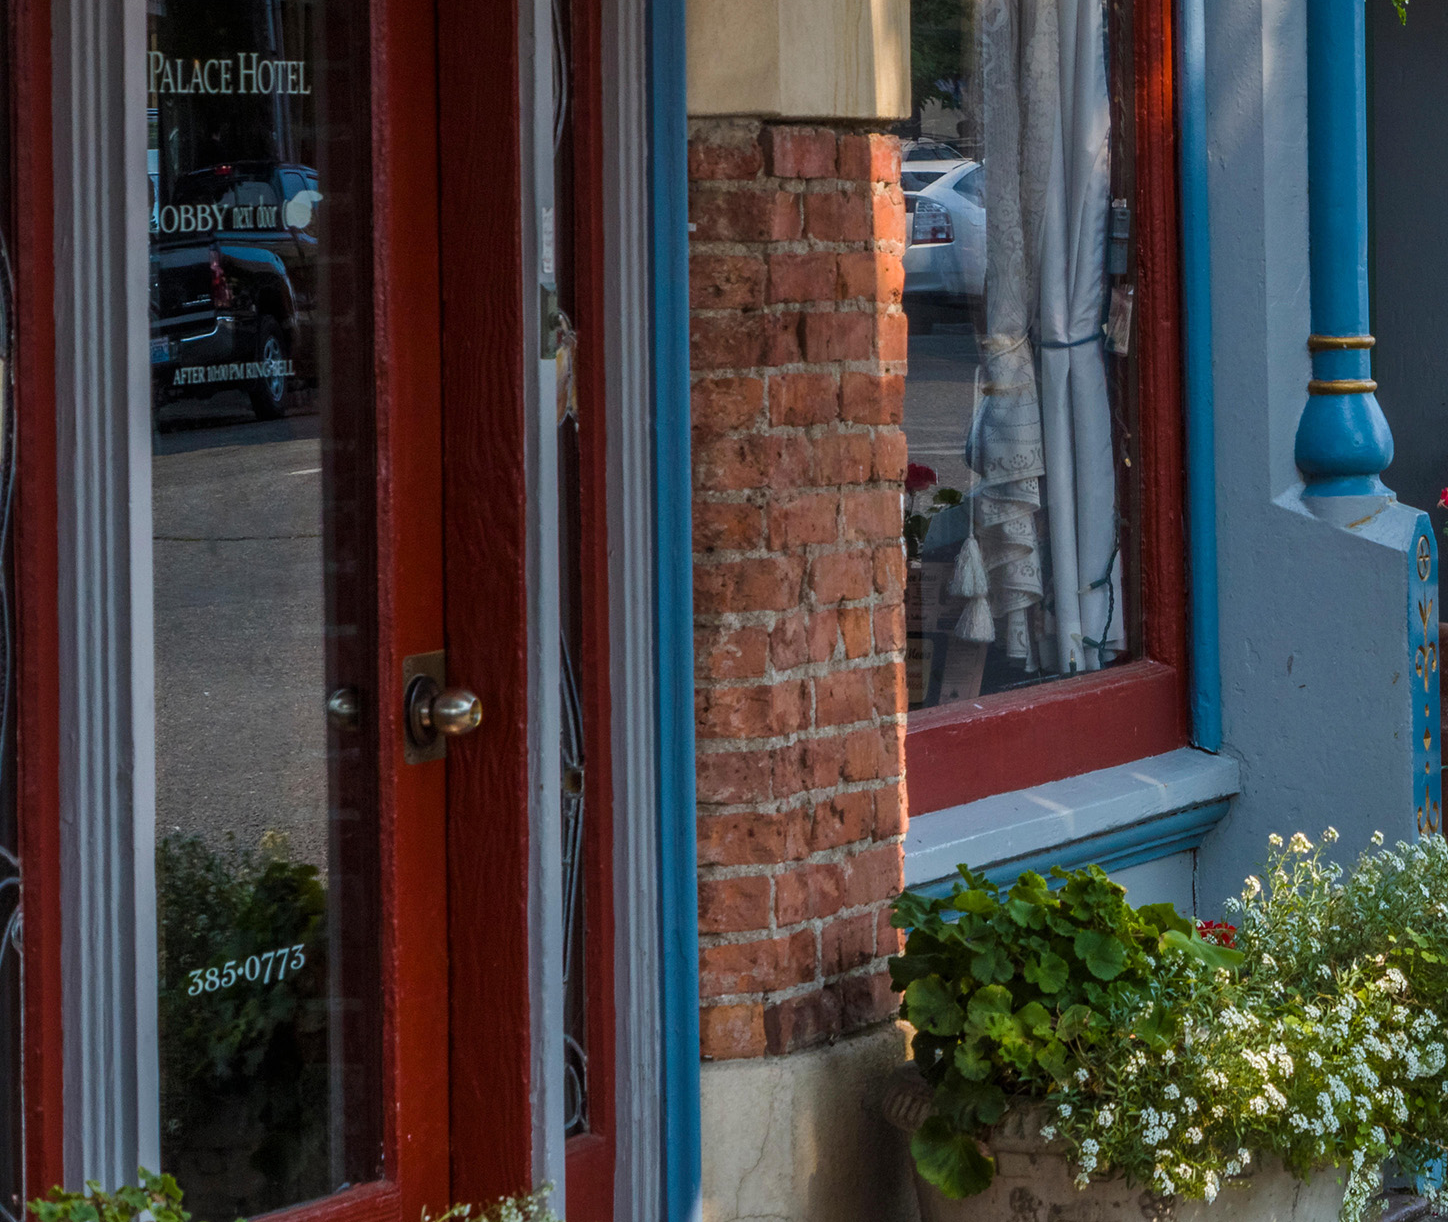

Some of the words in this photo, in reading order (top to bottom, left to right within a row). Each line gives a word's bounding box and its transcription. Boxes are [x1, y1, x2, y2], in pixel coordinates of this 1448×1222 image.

[147, 50, 234, 95] PALACE
[237, 52, 312, 95] HOTEL
[232, 203, 254, 229] next
[256, 194, 278, 229] door
[173, 365, 206, 386] AFTER
[229, 363, 245, 381] PM
[245, 360, 270, 379] RING
[272, 359, 296, 377] BELL
